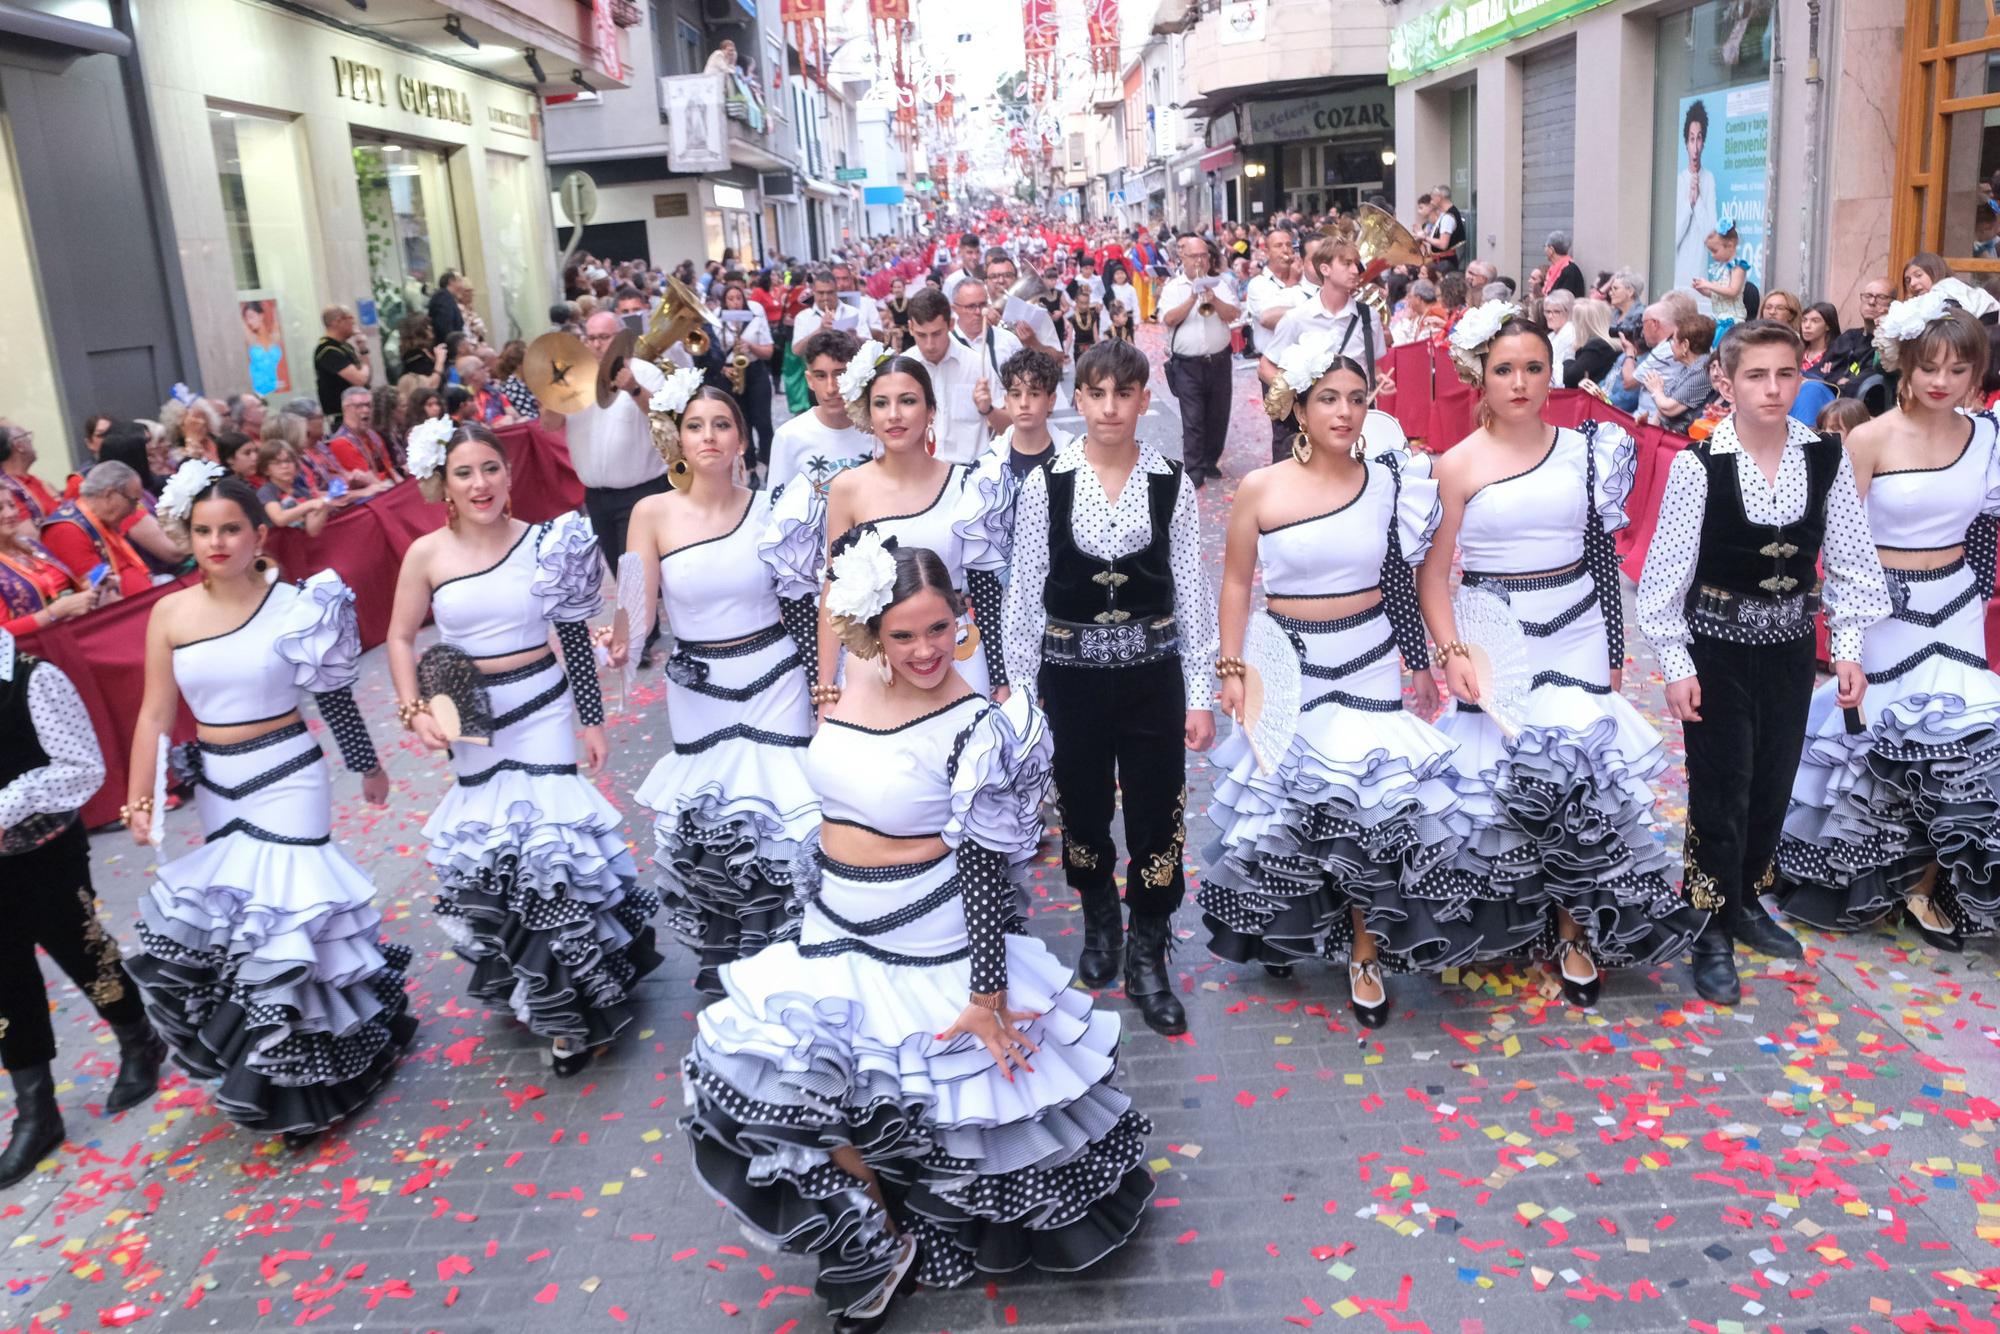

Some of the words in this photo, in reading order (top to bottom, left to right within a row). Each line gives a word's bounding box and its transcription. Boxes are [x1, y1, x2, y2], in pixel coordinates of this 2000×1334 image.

[332, 56, 387, 107] PEPI
[398, 73, 472, 126] GUERRA
[1314, 103, 1390, 130] COZAR
